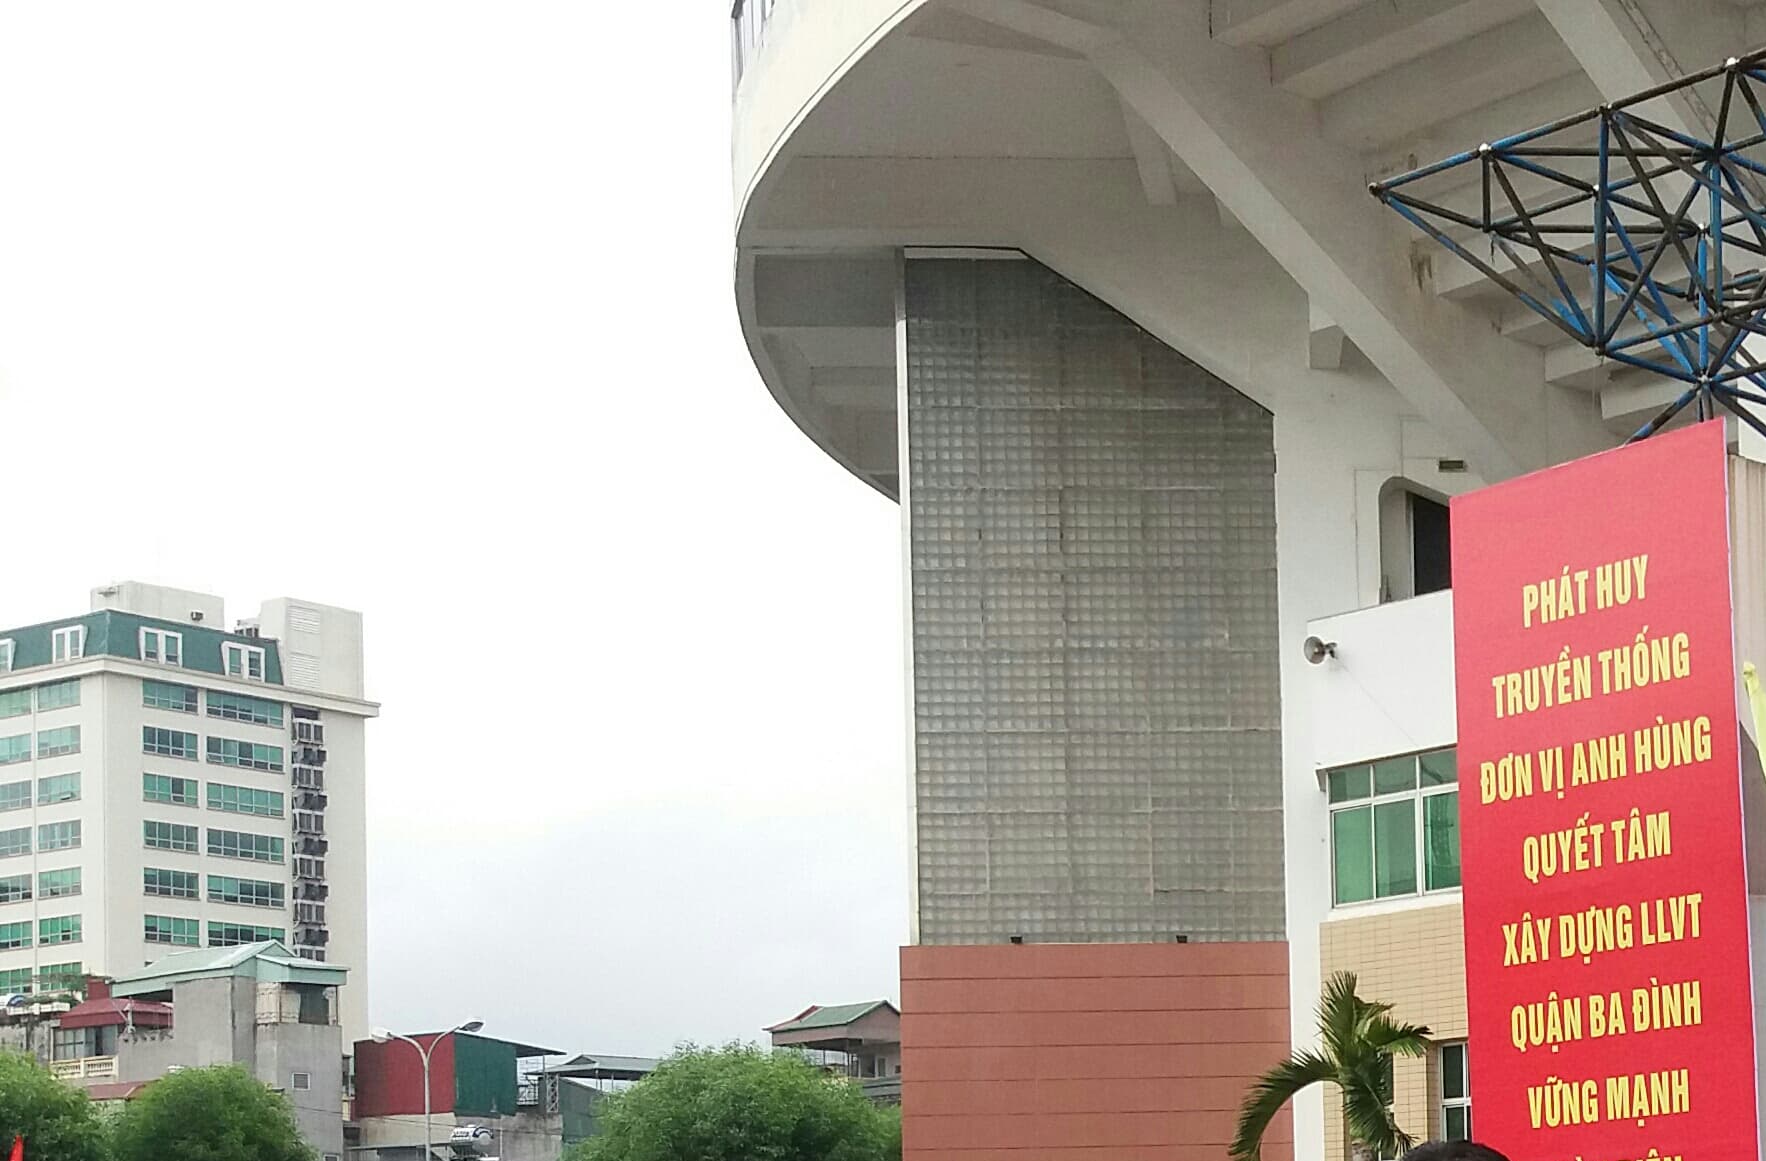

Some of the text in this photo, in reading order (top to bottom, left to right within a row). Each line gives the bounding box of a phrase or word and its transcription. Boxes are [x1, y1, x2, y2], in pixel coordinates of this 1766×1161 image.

[1522, 553, 1649, 629] PHÁT HUY
[1491, 624, 1691, 719] TRUYỀN THỐNG
[1479, 715, 1712, 805] ĐƠN VỊ ANH HÙNG
[1523, 807, 1671, 884] QUYẾT TÂM
[1502, 893, 1702, 967] XÂY DỰNG LLVT
[1511, 977, 1702, 1053] QUẬN BA ĐÌNH
[1527, 1068, 1690, 1129] VỮNG MẠNH
